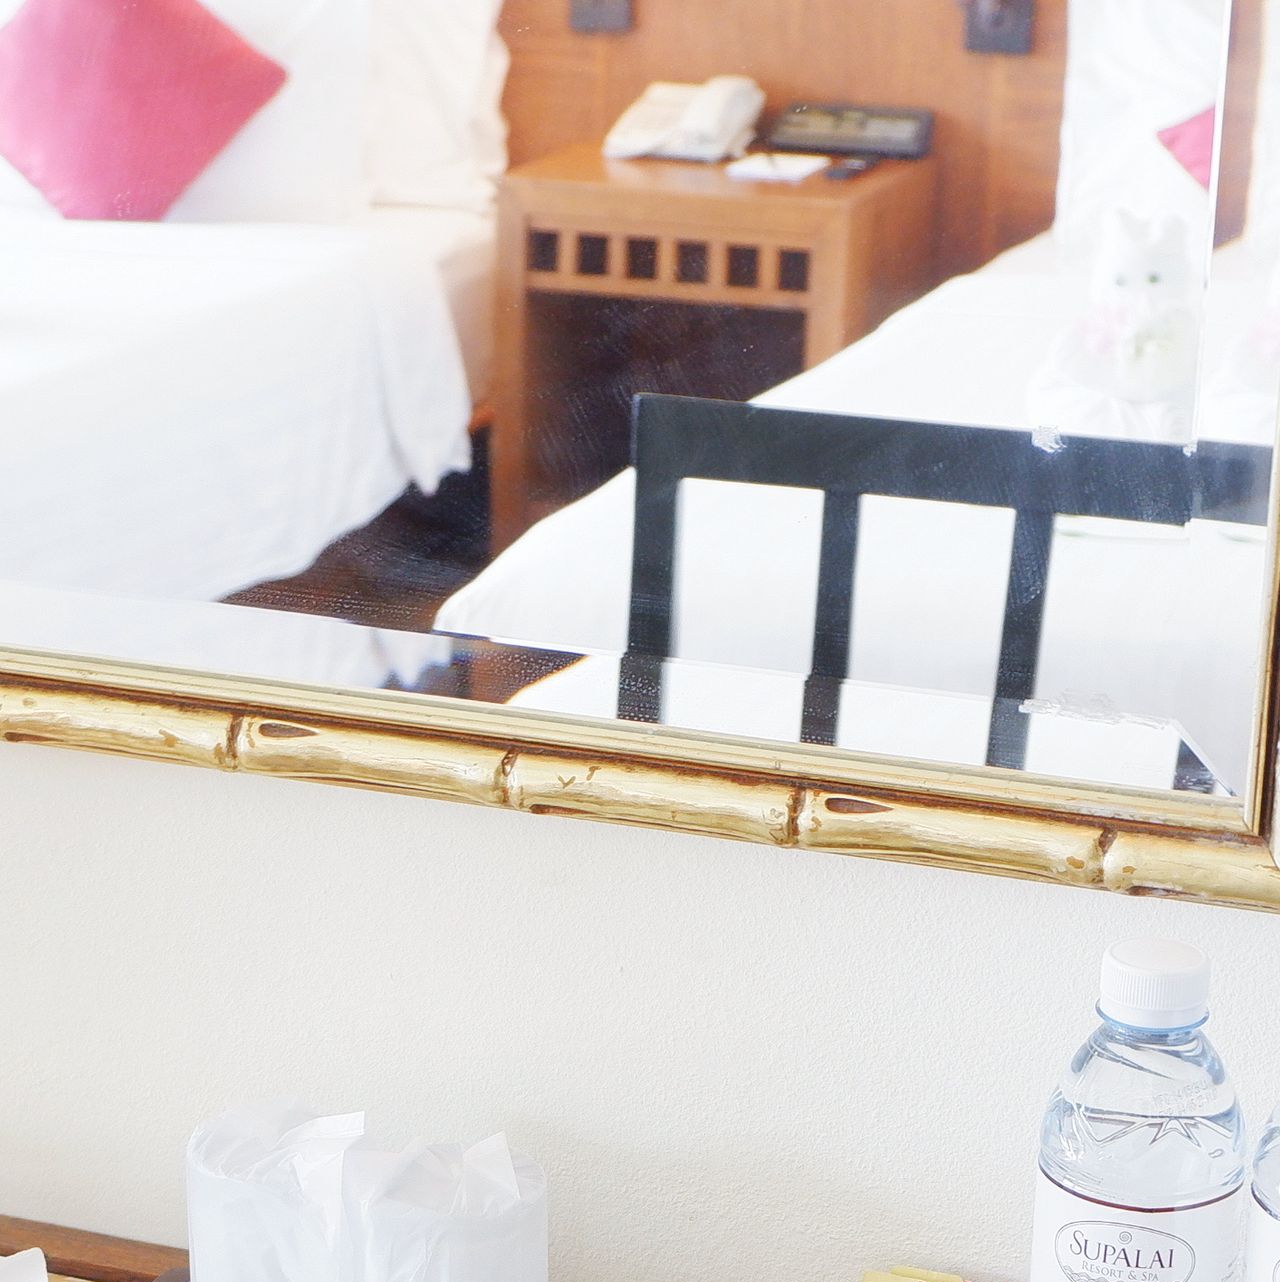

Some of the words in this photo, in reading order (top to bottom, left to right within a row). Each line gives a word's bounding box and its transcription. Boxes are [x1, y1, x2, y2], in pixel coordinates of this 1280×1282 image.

[1069, 1231, 1175, 1270] SUPALAI
[1081, 1259, 1125, 1279] RESORT
[1128, 1270, 1138, 1280] &
[1141, 1272, 1159, 1281] SPA
